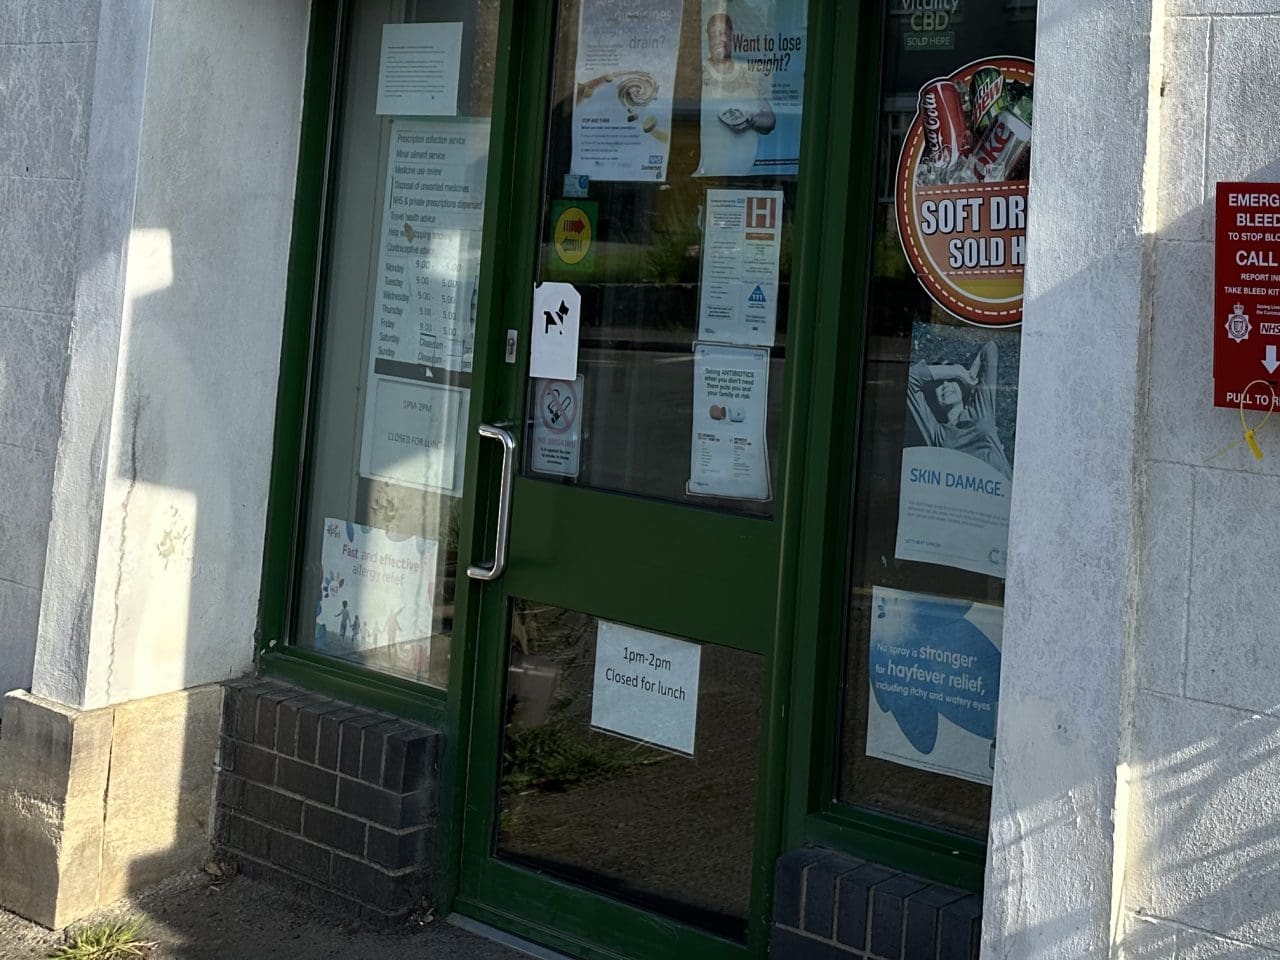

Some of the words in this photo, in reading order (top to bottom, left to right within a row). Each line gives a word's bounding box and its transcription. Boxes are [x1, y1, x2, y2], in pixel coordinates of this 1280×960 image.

[910, 10, 949, 32] CBD
[629, 35, 665, 49] drain?
[733, 34, 760, 53] Want
[764, 34, 774, 52] to
[778, 33, 801, 51] lose
[906, 35, 927, 47] SOLD
[929, 36, 951, 46] HERE
[747, 52, 791, 76] weight?
[752, 199, 771, 227] H
[920, 197, 983, 236] SOFT
[1228, 232, 1239, 241] TO
[1241, 232, 1263, 241] STOP
[948, 237, 1007, 270] SOLD
[1236, 250, 1278, 267] CALL
[1240, 273, 1270, 282] REPORT
[1224, 286, 1242, 295] TAKE
[1243, 287, 1266, 296] BLEED
[1266, 288, 1280, 296] KIT
[1261, 324, 1280, 333] NHS
[721, 370, 754, 378] ANTIBIOTICS
[1226, 392, 1252, 405] PULL
[1254, 394, 1269, 406] TO
[910, 468, 940, 486] SKIN
[946, 473, 1005, 497] DAMAGE.
[342, 544, 358, 559] Fast
[361, 550, 377, 563] and
[380, 553, 419, 571] effective
[352, 564, 380, 581] allergy
[623, 646, 672, 672] 1pm-2pm
[877, 643, 887, 652] No
[890, 646, 910, 658] spray
[912, 649, 917, 658] is
[605, 668, 638, 688] Closed
[640, 675, 656, 693] for
[657, 679, 686, 701] lunch
[876, 663, 886, 674] for
[888, 660, 945, 684] hayfever
[949, 673, 985, 696] relief,
[875, 681, 909, 696] including
[910, 689, 928, 701] itchy
[929, 692, 943, 701] and
[945, 694, 971, 709] watery
[973, 701, 990, 711] eyes
